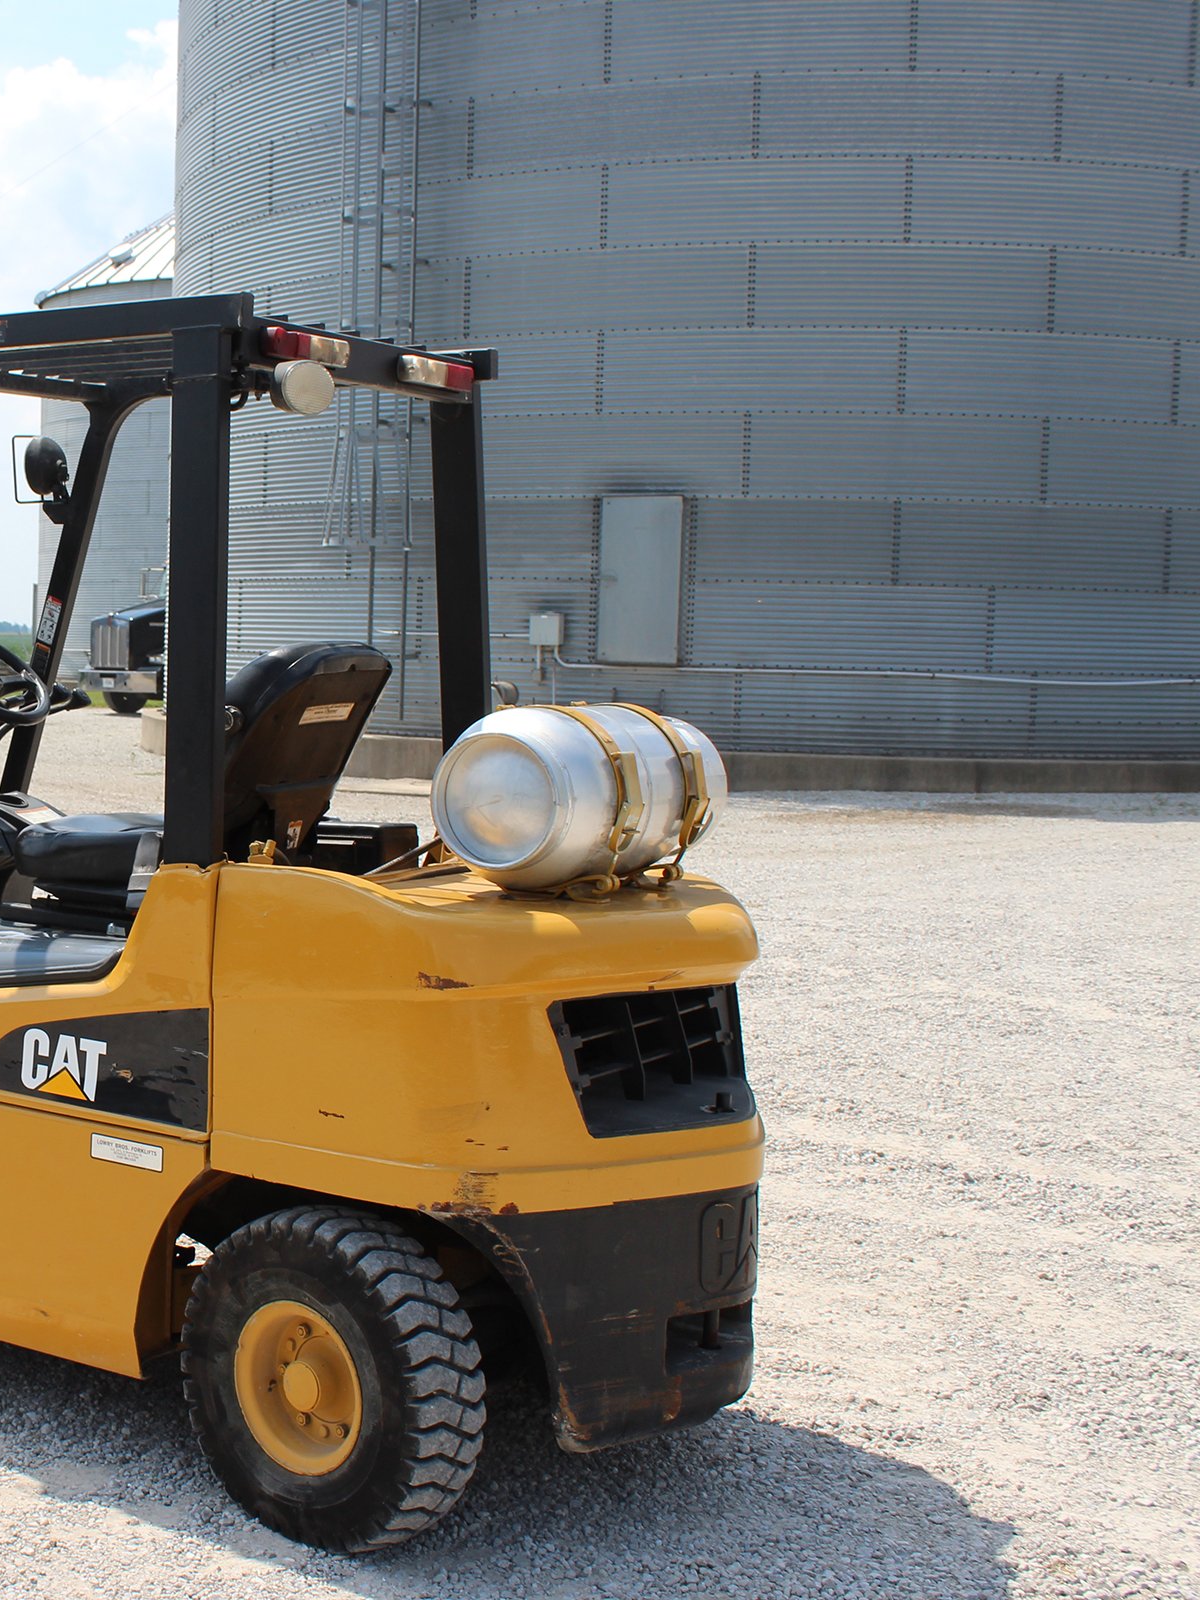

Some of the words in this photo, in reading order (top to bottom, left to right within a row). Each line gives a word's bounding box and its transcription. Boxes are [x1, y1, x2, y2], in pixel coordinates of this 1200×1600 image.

[21, 1028, 107, 1102] CAT
[97, 1139, 113, 1147] LOWRY
[115, 1143, 129, 1151] BROS.
[131, 1147, 157, 1156] FORKLIFTS
